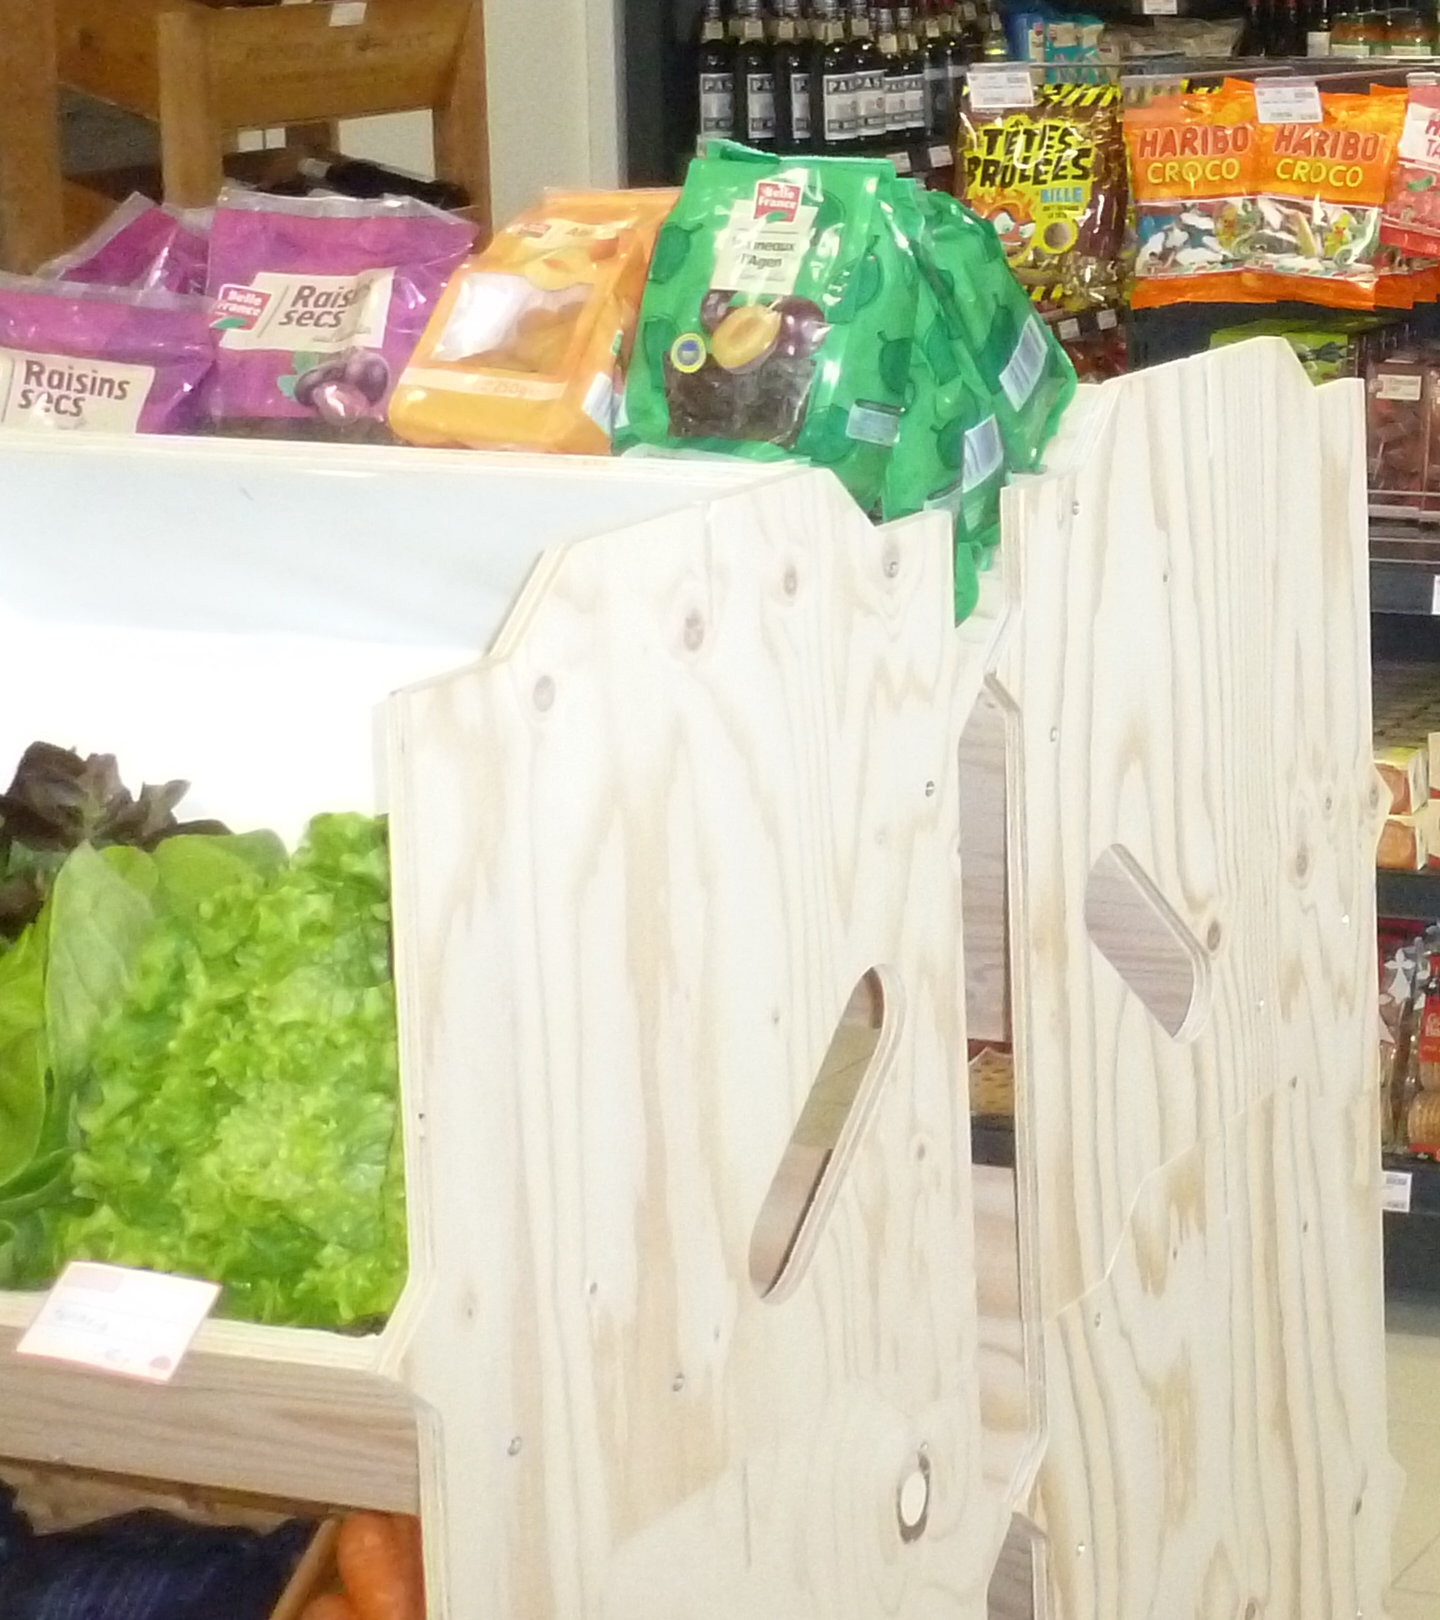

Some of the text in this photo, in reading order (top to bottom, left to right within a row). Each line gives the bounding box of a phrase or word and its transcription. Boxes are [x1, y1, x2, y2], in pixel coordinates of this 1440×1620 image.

[1138, 124, 1252, 159] HARIBO
[1272, 123, 1383, 162] HARIBO
[1147, 157, 1240, 185] CROCO
[1276, 157, 1363, 188] CROCO
[758, 196, 797, 209] France
[764, 185, 795, 199] Belle
[279, 307, 347, 329] secs
[23, 360, 131, 401] Raisins
[18, 388, 87, 418] secs
